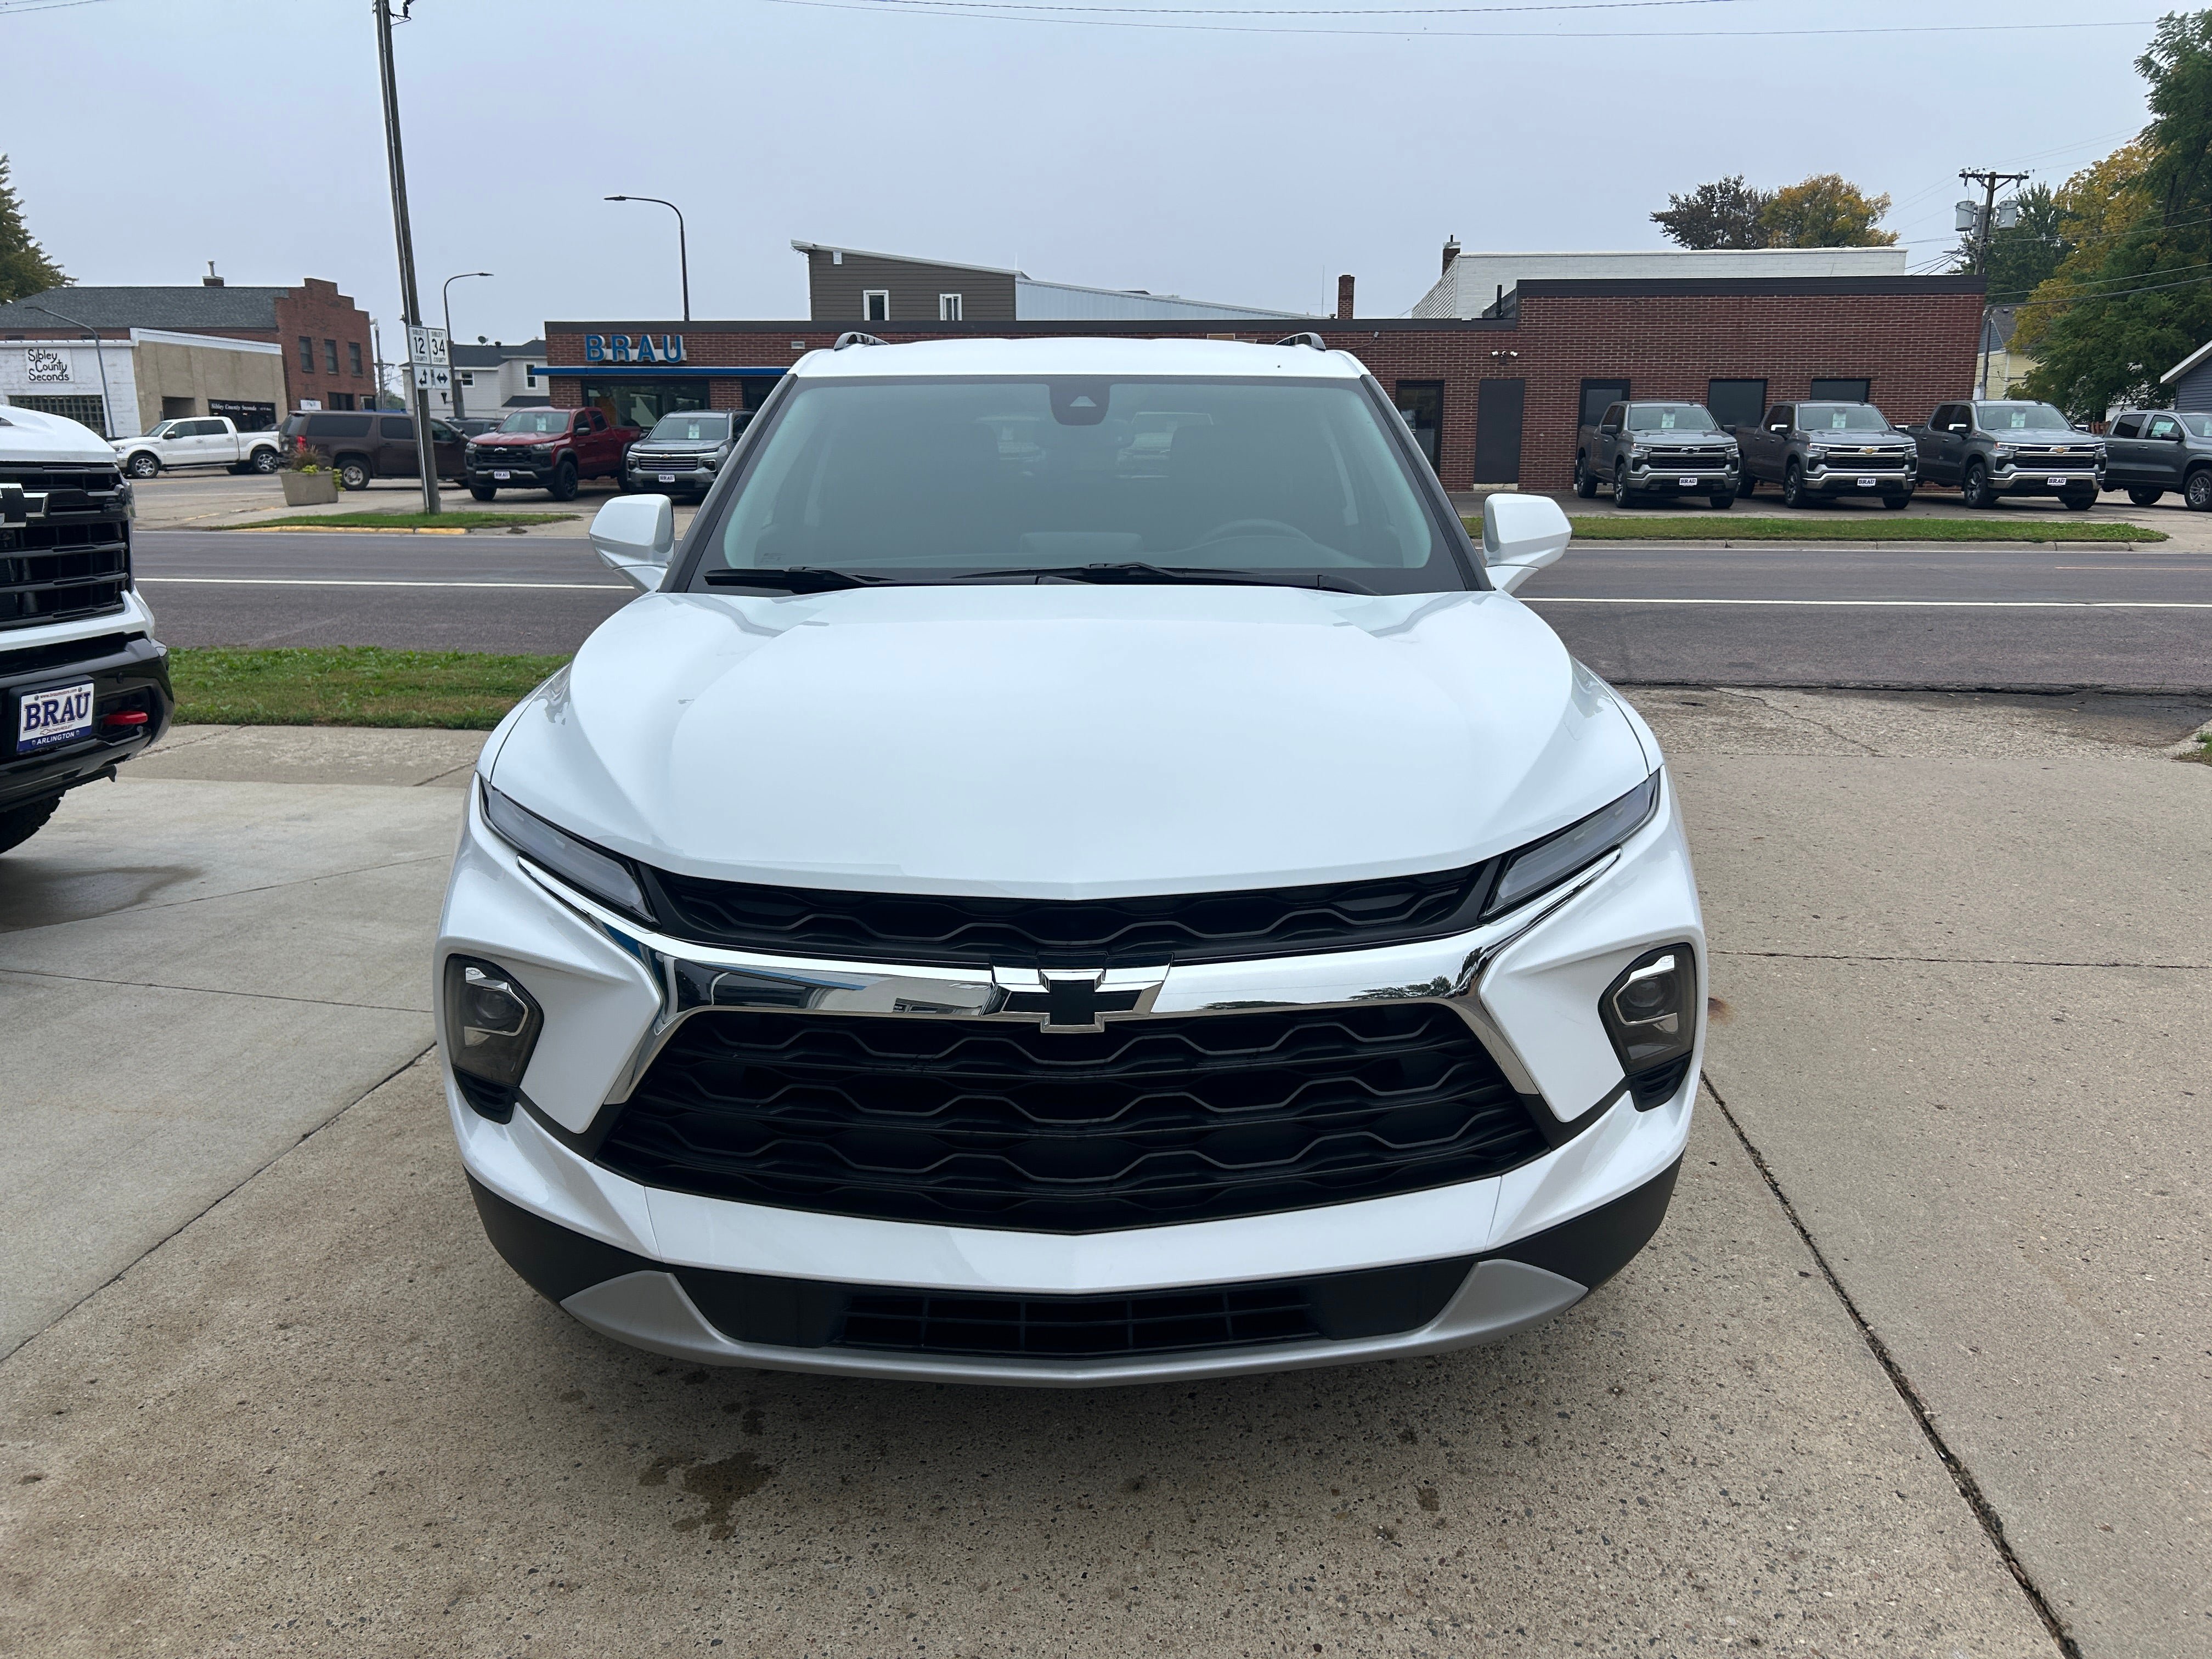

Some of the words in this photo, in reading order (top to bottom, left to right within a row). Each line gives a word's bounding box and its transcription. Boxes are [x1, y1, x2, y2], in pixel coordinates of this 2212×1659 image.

[414, 336, 425, 354] 12
[432, 338, 445, 356] 34
[585, 334, 682, 363] BRAU
[28, 348, 58, 363] Sibley
[29, 368, 70, 381] Seconds
[35, 359, 67, 374] County
[23, 691, 91, 733] BRAU
[37, 731, 75, 746] ARLINGTON
